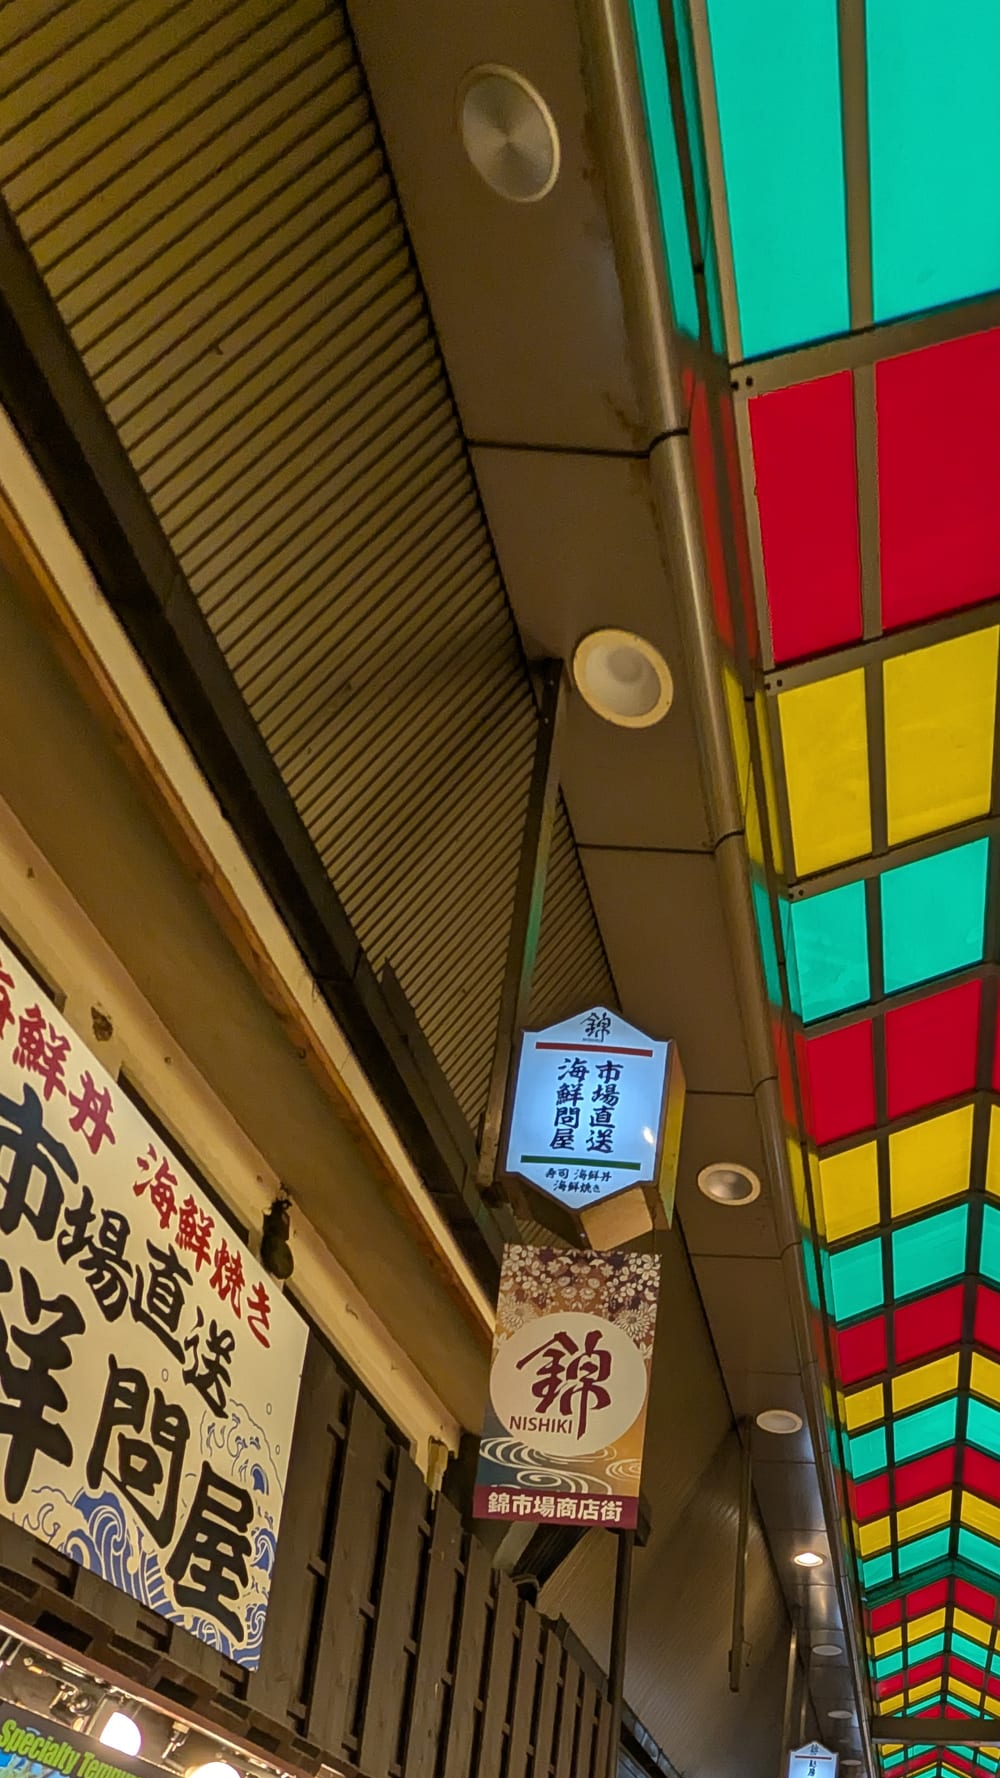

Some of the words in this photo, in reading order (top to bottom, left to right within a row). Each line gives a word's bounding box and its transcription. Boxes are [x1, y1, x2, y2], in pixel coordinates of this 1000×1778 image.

[580, 1012, 612, 1042] 錦
[550, 1057, 590, 1151] 海鮮問屋
[586, 1060, 624, 1153] 市場直送
[545, 1168, 570, 1179] 寿司
[574, 1169, 612, 1182] 海鮮丼
[553, 1179, 601, 1193] 海鮮焼き
[133, 1145, 275, 1350] 海鮮焼き
[515, 1329, 611, 1441] 錦
[509, 1414, 573, 1436] NISHIKI
[487, 1490, 623, 1524] 錦市場商店街
[0, 1719, 81, 1775] Specialty
